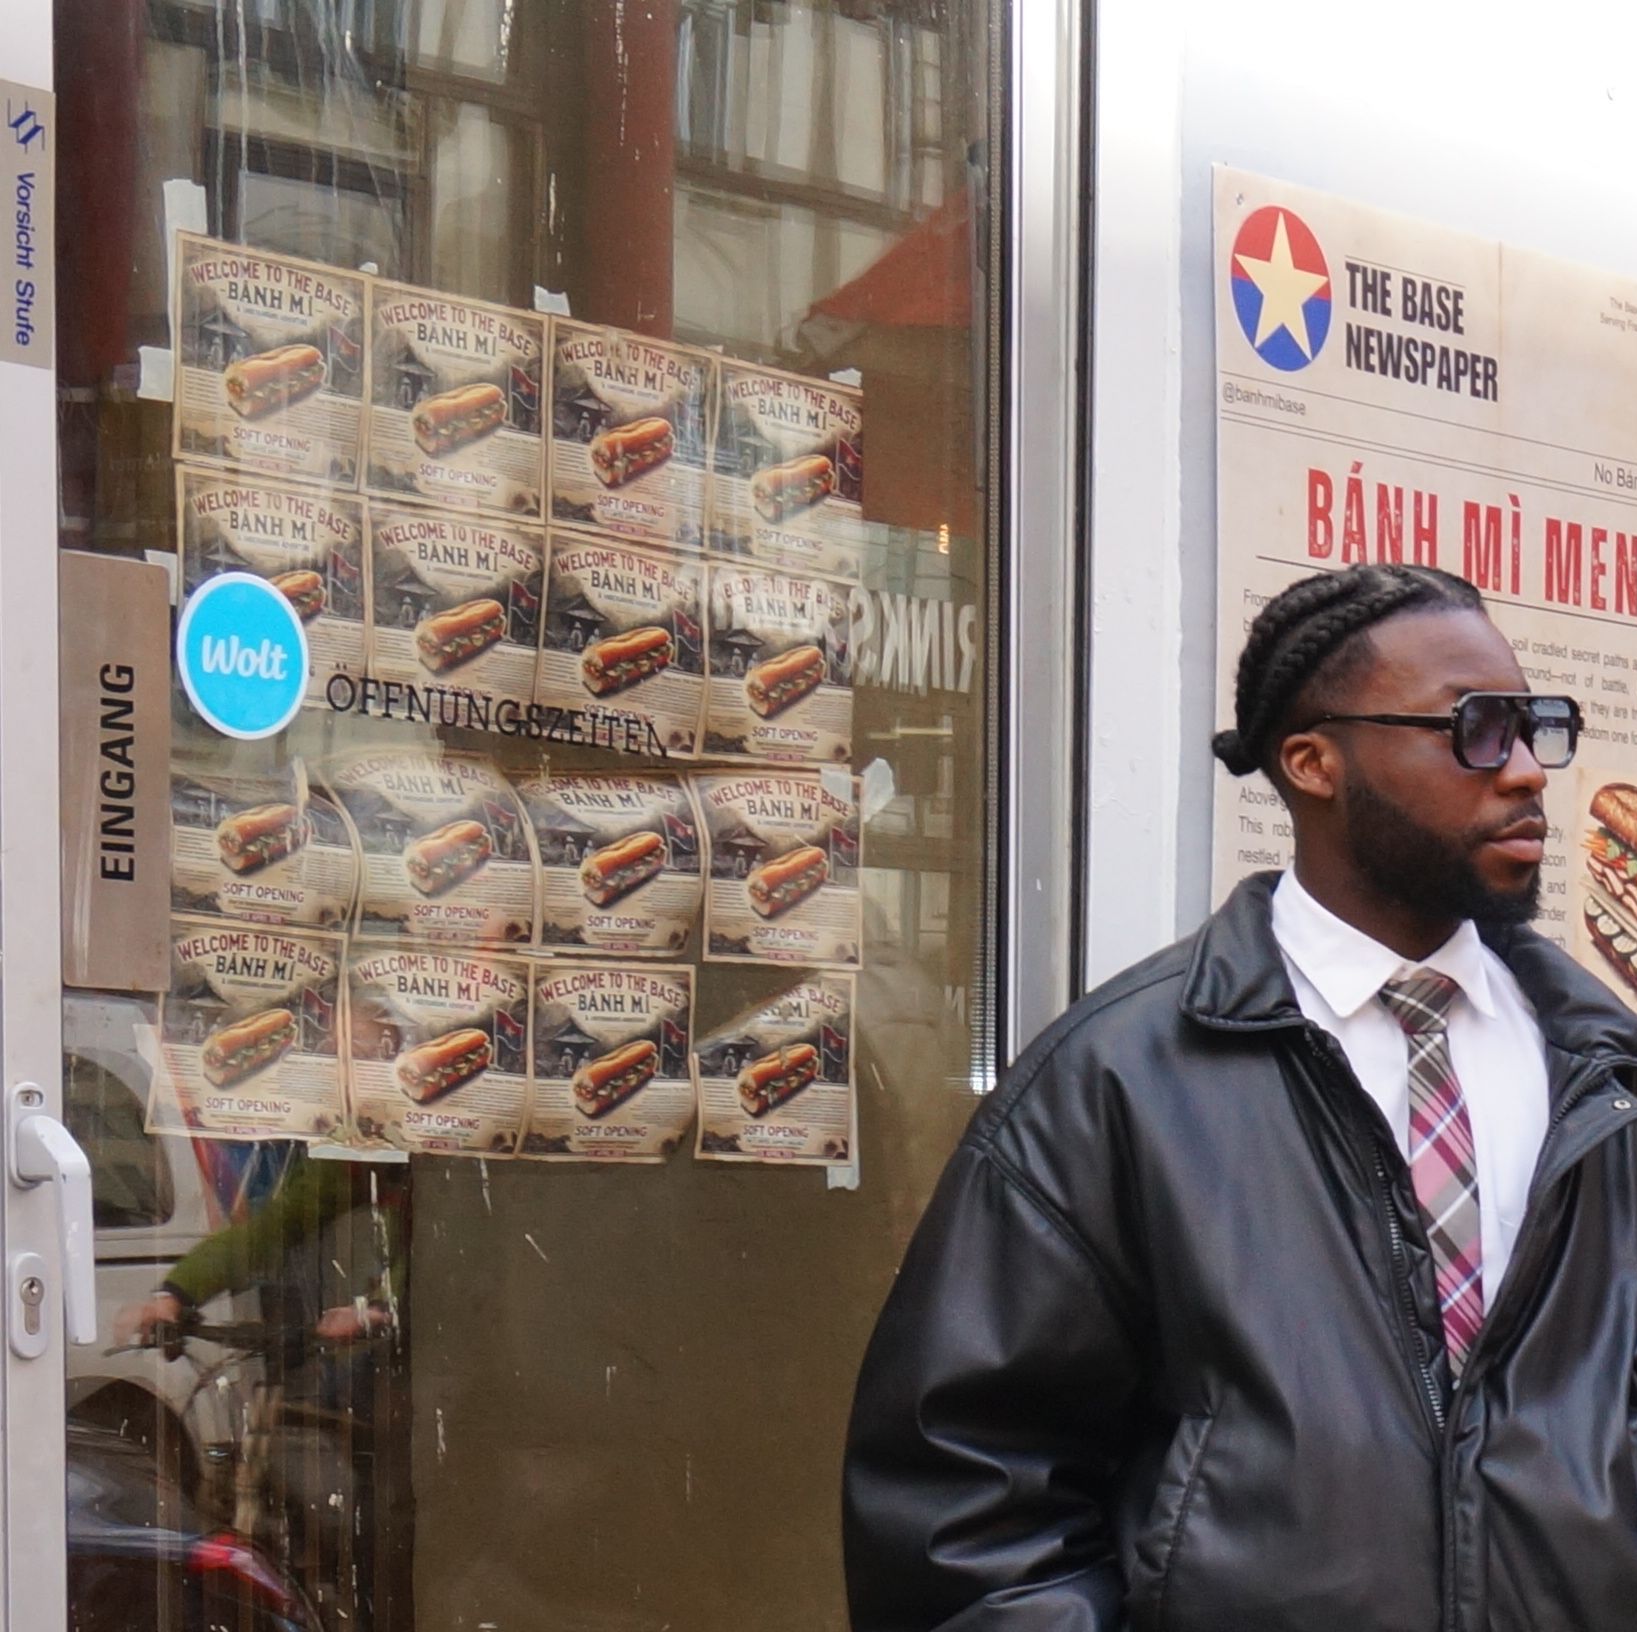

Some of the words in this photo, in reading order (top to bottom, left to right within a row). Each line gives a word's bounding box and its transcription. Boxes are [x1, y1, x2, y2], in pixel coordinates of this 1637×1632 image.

[16, 172, 35, 270] Vorsicht
[191, 260, 260, 284] WELCOME
[265, 264, 282, 283] TO
[287, 270, 313, 293] THE
[315, 279, 351, 317] BASE
[1345, 262, 1392, 317] THE
[1402, 276, 1464, 335] BASE
[16, 279, 35, 346] Stufe
[381, 303, 447, 326] WELCOME
[451, 306, 466, 323] TO
[471, 312, 494, 333] THE
[499, 326, 532, 355] BASE
[626, 344, 639, 360] TO
[643, 349, 665, 370] THE
[1346, 322, 1498, 402] NEWSPAPER
[787, 382, 800, 399] TO
[804, 388, 826, 409] THE
[829, 399, 857, 430] BASE
[1222, 382, 1307, 416] @banhmibase
[1594, 463, 1612, 484] No
[193, 490, 260, 515] WELCOME
[265, 492, 282, 509] TO
[286, 496, 313, 519] THE
[318, 508, 349, 540] BASE
[1307, 460, 1438, 569] BÁNH
[1462, 492, 1521, 595] MÌ
[380, 522, 446, 547] WELCOME
[452, 526, 467, 542] TO
[471, 529, 495, 550] THE
[500, 539, 533, 569] BASE
[557, 550, 617, 573] WELCOME
[621, 554, 634, 571] TO
[638, 559, 659, 581] THE
[789, 577, 811, 598] THE
[202, 635, 288, 680] Wolt
[1532, 642, 1567, 658] cradled
[1572, 648, 1600, 665] secret
[1604, 654, 1628, 667] paths
[1585, 674, 1593, 688] of
[326, 663, 667, 758] ÖFFNUNGSZEITEN
[1591, 702, 1609, 719] they
[1614, 706, 1628, 718] are
[752, 726, 777, 740] SOFT
[779, 728, 818, 741] OPENING
[1612, 732, 1628, 744] one
[100, 664, 135, 882] EINGANG
[432, 759, 453, 775] THE
[605, 779, 629, 792] THE
[709, 780, 773, 806] WELCOME
[775, 780, 791, 795] TO
[795, 783, 817, 800] THE
[821, 786, 848, 816] BASE
[1238, 816, 1263, 834] This
[1238, 849, 1280, 865] nestled
[223, 882, 252, 897] SOFT
[255, 886, 304, 902] OPENING
[1547, 880, 1566, 894] and
[414, 905, 441, 917] SOFT
[445, 906, 489, 919] OPENING
[587, 915, 611, 928] SOFT
[615, 918, 656, 929] OPENING
[178, 934, 249, 961] WELCOME
[254, 935, 268, 952] TO
[273, 939, 296, 958] THE
[298, 948, 328, 976] BASE
[358, 955, 427, 981] WELCOME
[432, 956, 448, 973] TO
[453, 960, 477, 980] THE
[482, 967, 516, 998] BASE
[541, 973, 605, 1002] WELCOME
[609, 973, 623, 988] TO
[627, 974, 646, 993] THE
[651, 981, 682, 1008] BASE
[809, 988, 840, 1013] BASE
[206, 1097, 233, 1109] SOFT
[238, 1098, 291, 1113] OPENING
[406, 1112, 432, 1125] SOFT
[436, 1114, 480, 1129] OPENING
[576, 1126, 601, 1136] SOFT
